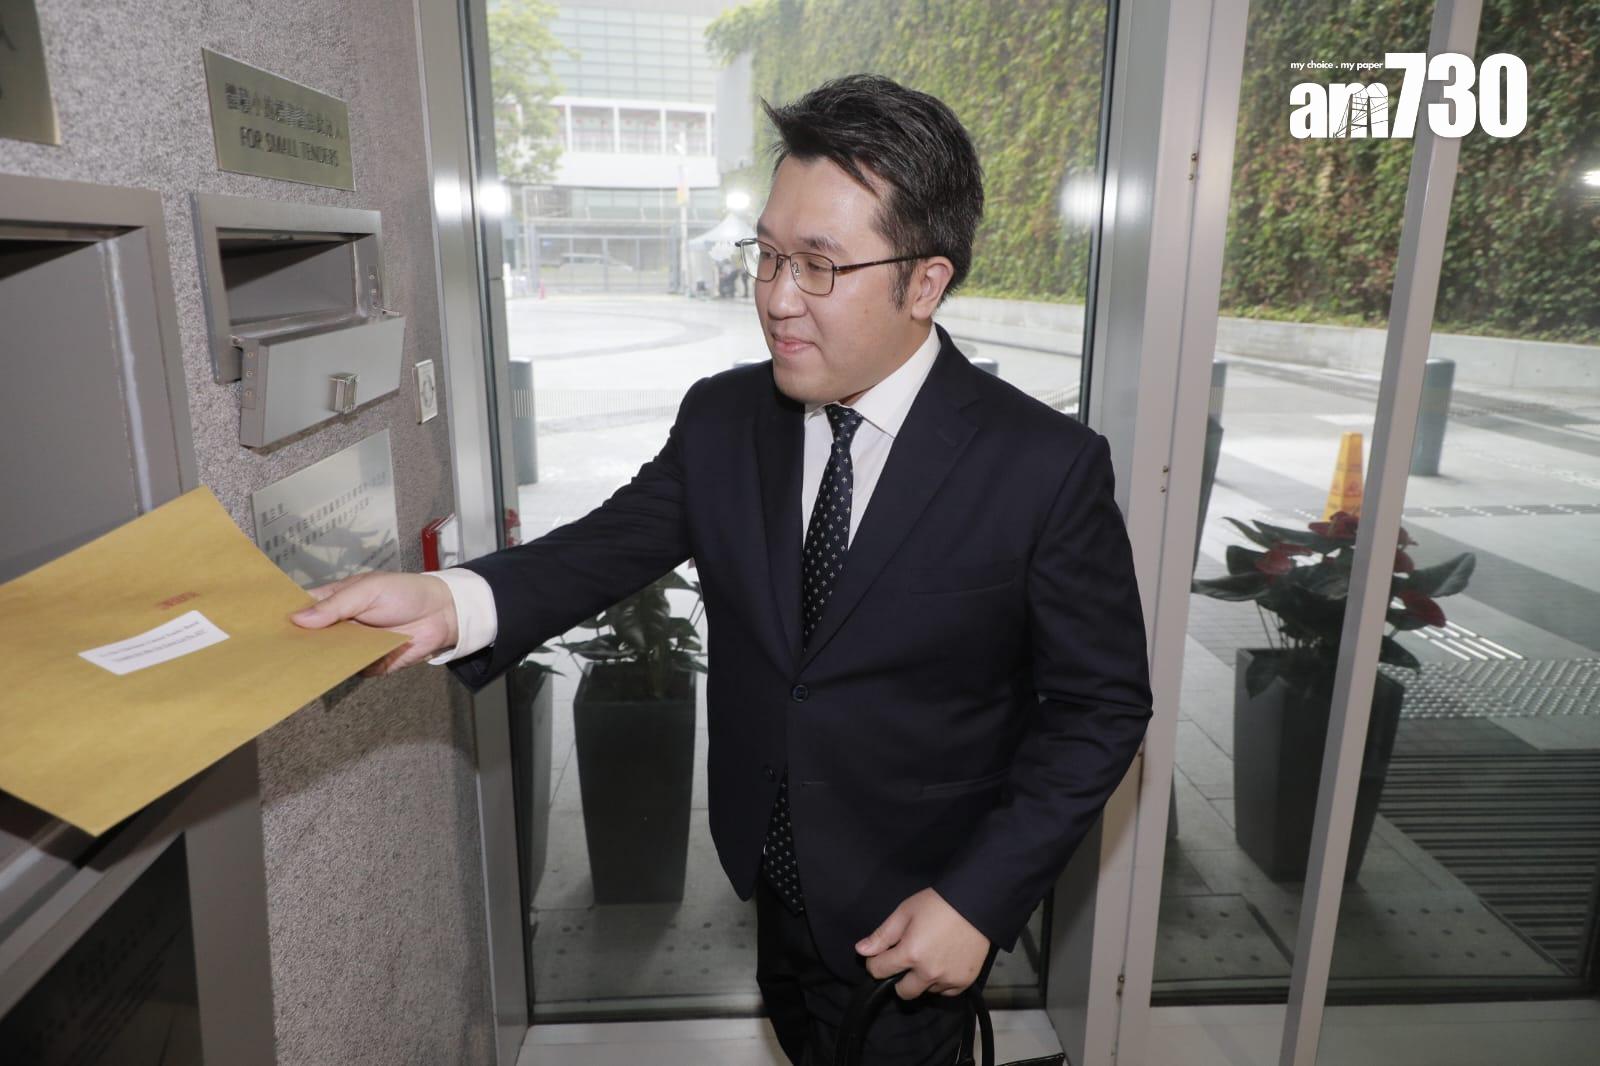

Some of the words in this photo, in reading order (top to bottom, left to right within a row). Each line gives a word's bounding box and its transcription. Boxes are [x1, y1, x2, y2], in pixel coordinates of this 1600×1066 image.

[240, 126, 262, 149] FOR
[265, 132, 300, 158] SMALL
[300, 141, 340, 168] TENDERS
